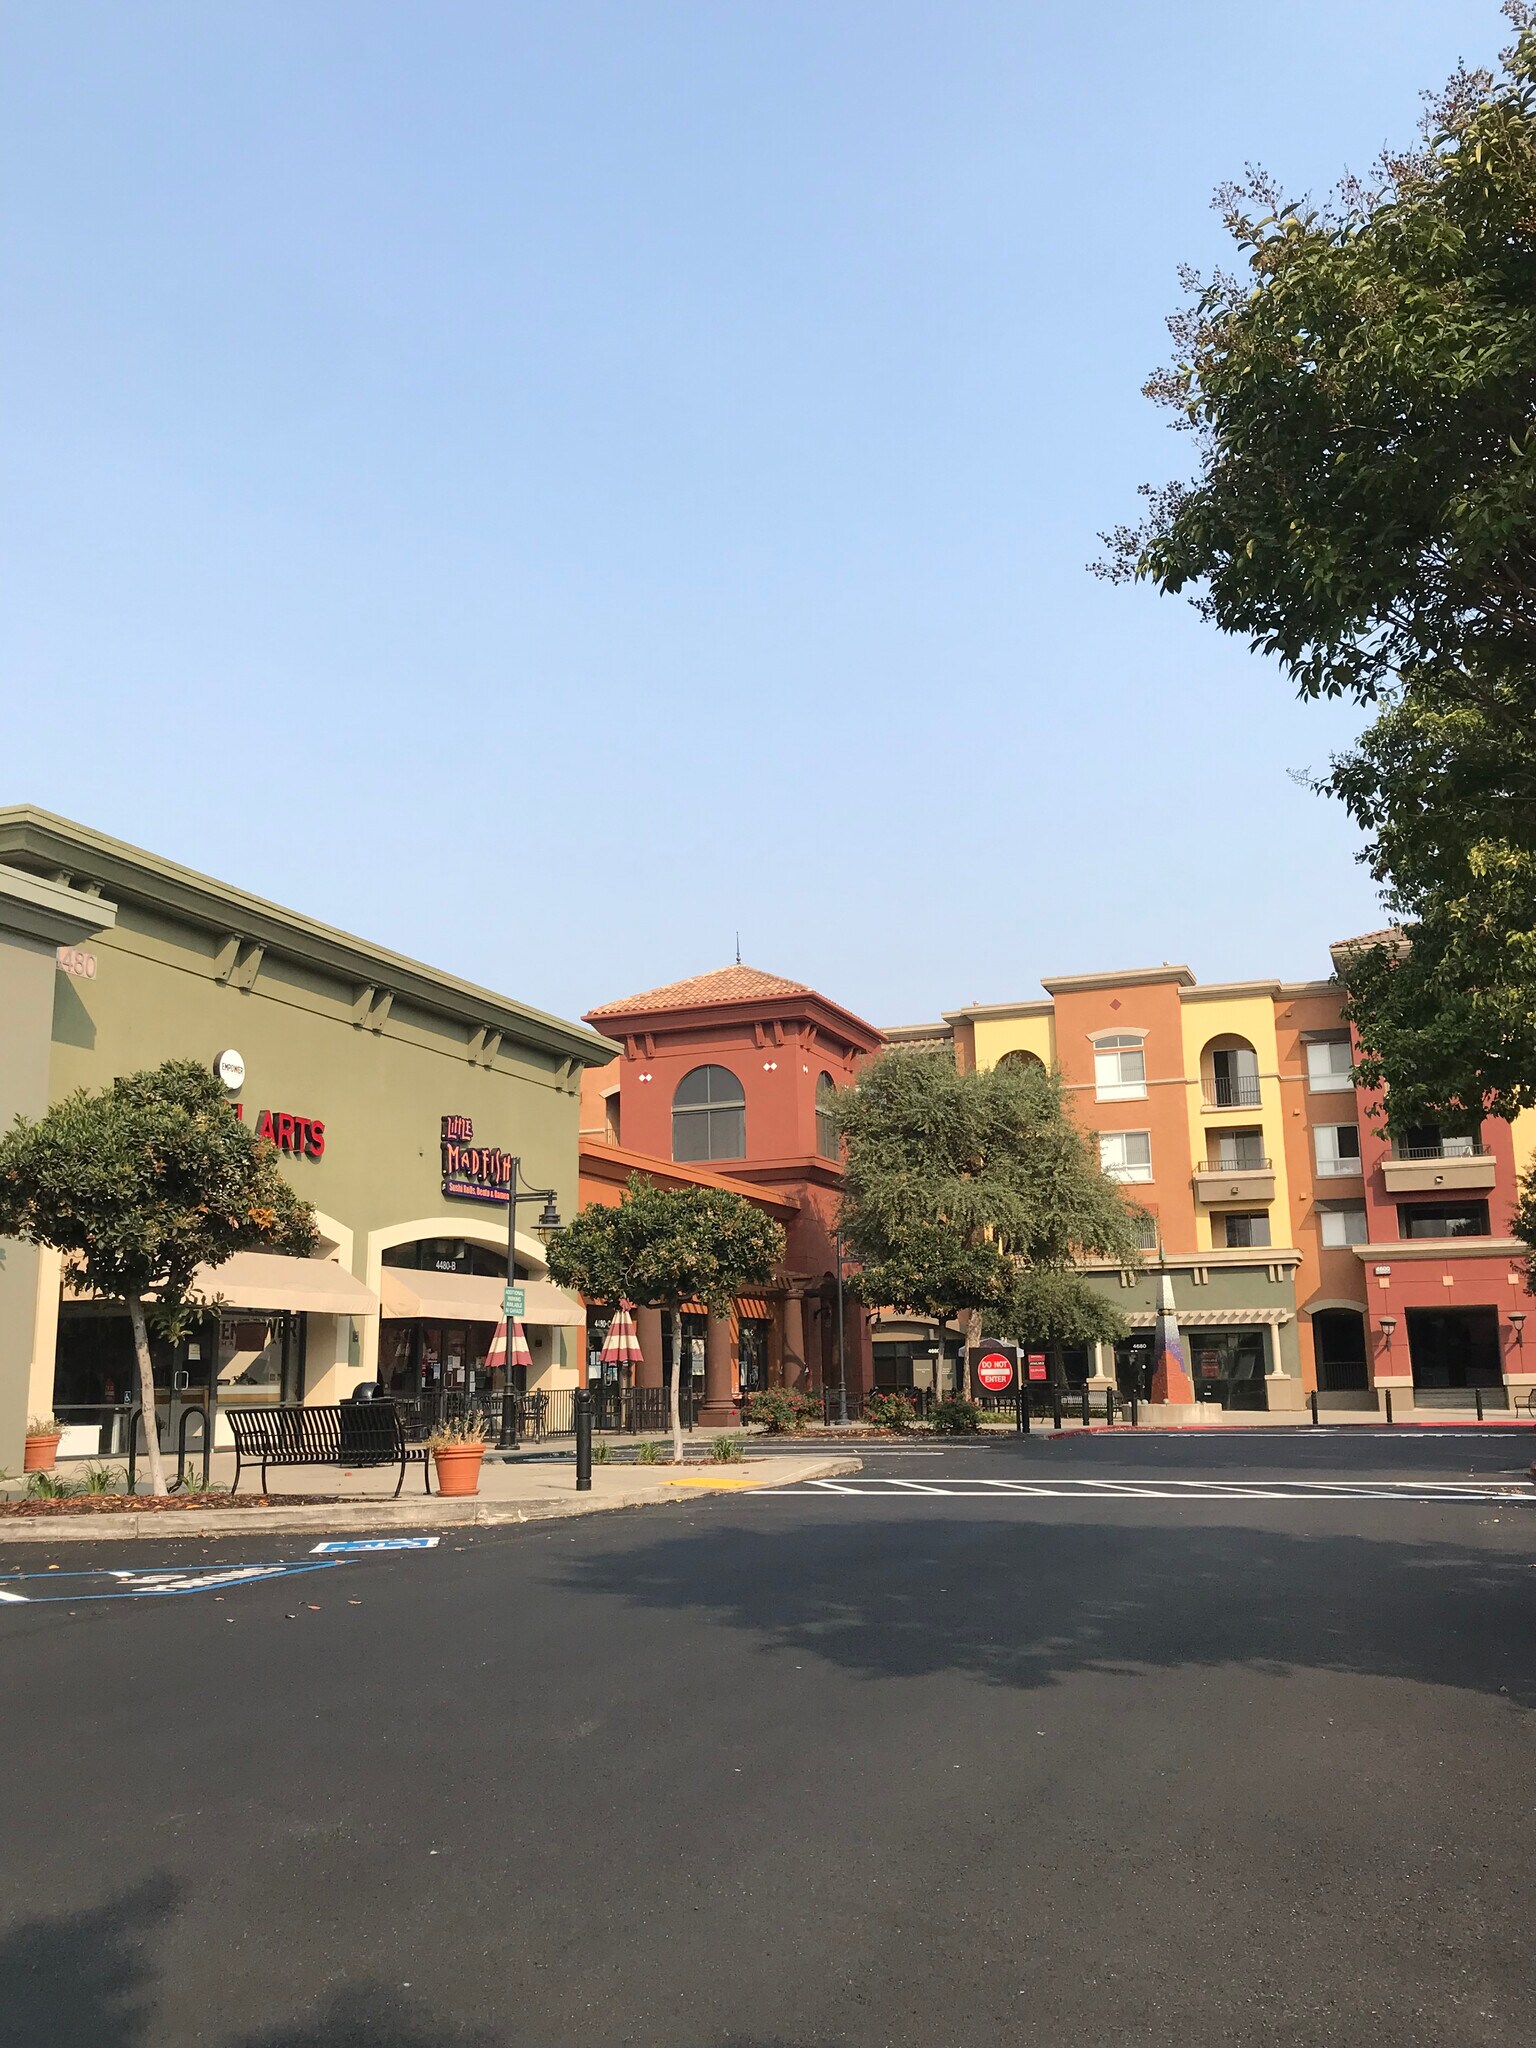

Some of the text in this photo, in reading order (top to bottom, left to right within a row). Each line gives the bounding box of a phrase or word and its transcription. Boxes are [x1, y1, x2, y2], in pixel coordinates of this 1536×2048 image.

[56, 950, 96, 978] 480
[222, 1062, 243, 1074] EMPOWER
[257, 1110, 325, 1156] ARTS
[449, 1182, 463, 1192] Sushi
[435, 1260, 456, 1271] 4480-B
[985, 1375, 1006, 1383] ENTER
